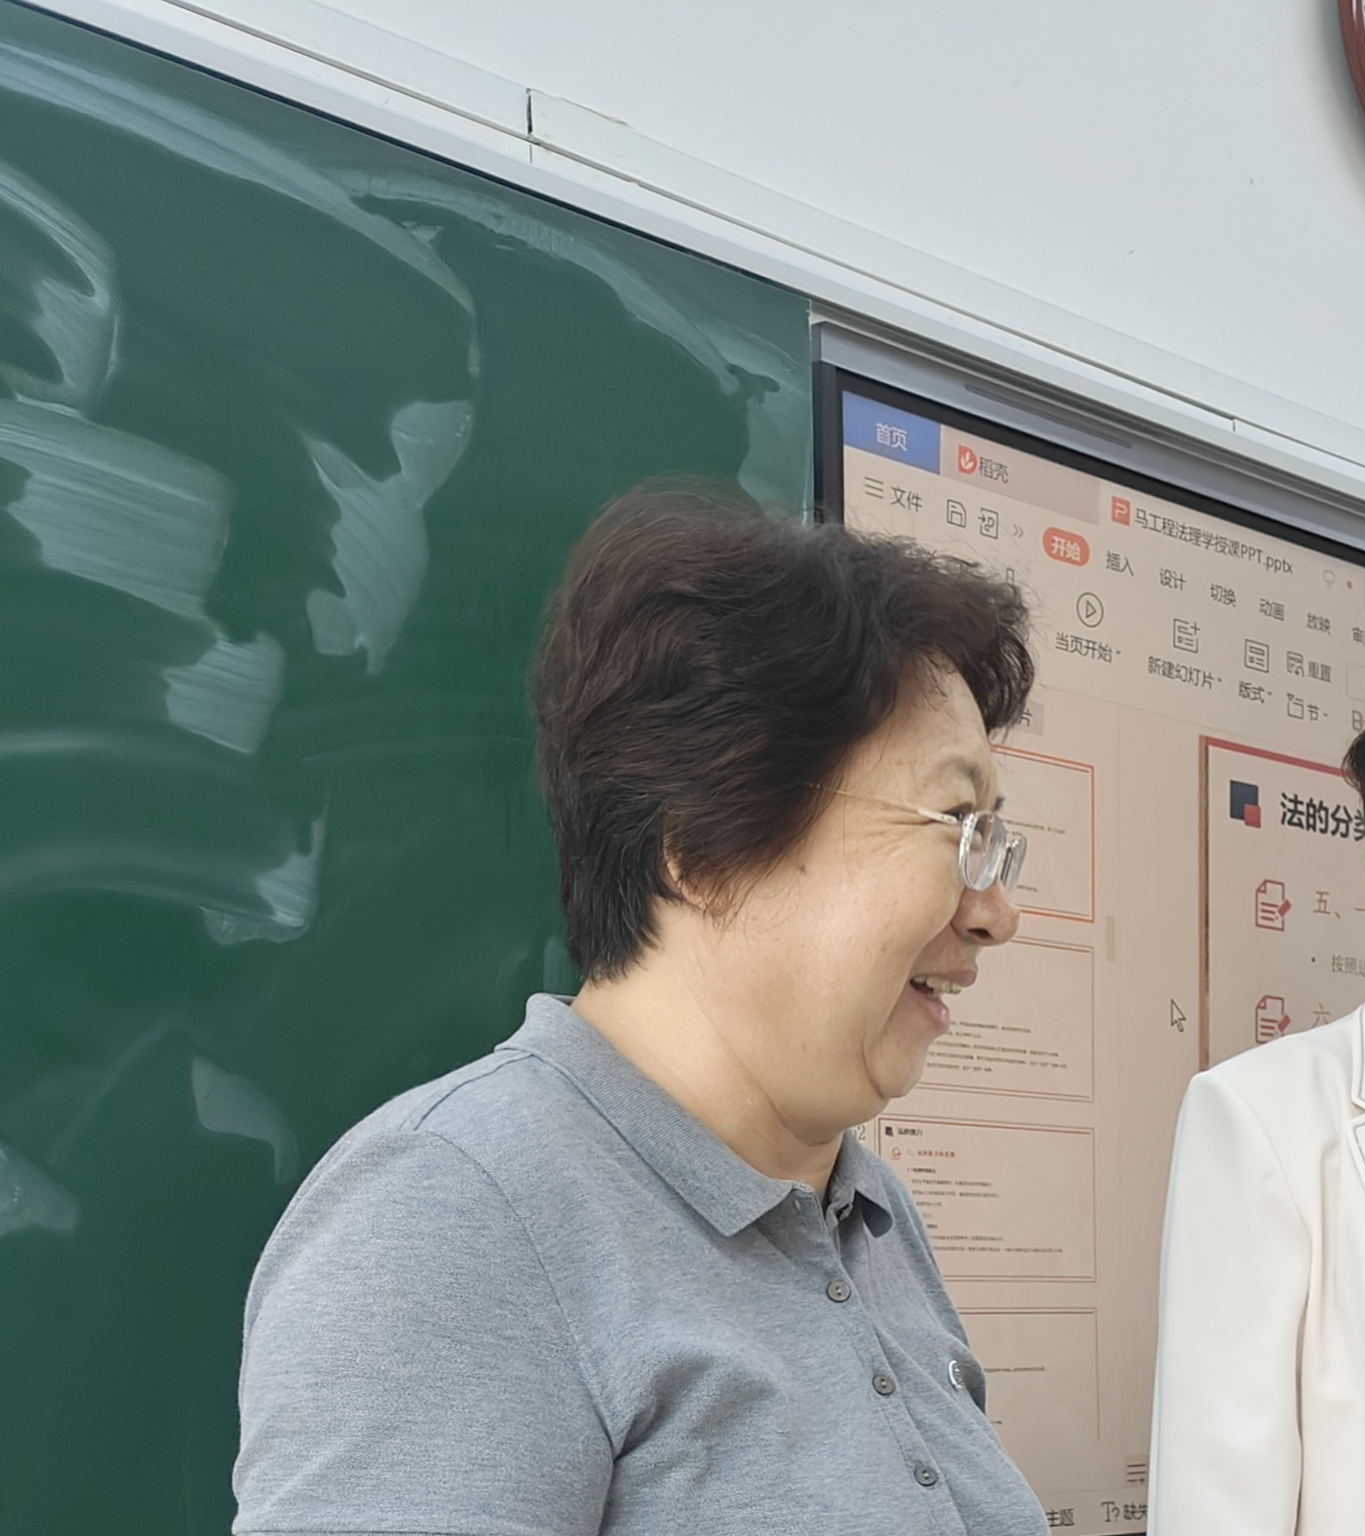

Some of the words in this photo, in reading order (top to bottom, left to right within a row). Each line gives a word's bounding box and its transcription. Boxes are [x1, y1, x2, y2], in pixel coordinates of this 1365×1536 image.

[876, 422, 908, 451] 首页
[979, 457, 1009, 483] 稻壳
[1134, 507, 1294, 576] 马工程法理学授课PPT.pptx
[890, 486, 923, 513] 文件
[1051, 535, 1081, 562] 开始
[1106, 551, 1135, 577] 插入
[1159, 567, 1187, 592] 设计
[1210, 582, 1237, 608] 切换
[1259, 597, 1285, 622] 动画
[1306, 612, 1332, 636] 放映
[1055, 631, 1113, 661] 当页开始
[1147, 656, 1214, 691] 新建幻灯片
[1308, 661, 1332, 683] 重置
[1238, 681, 1267, 703] 版式
[1307, 704, 1321, 722] 节
[1046, 1509, 1075, 1527] 主题
[1123, 1502, 1148, 1521] 缺失
